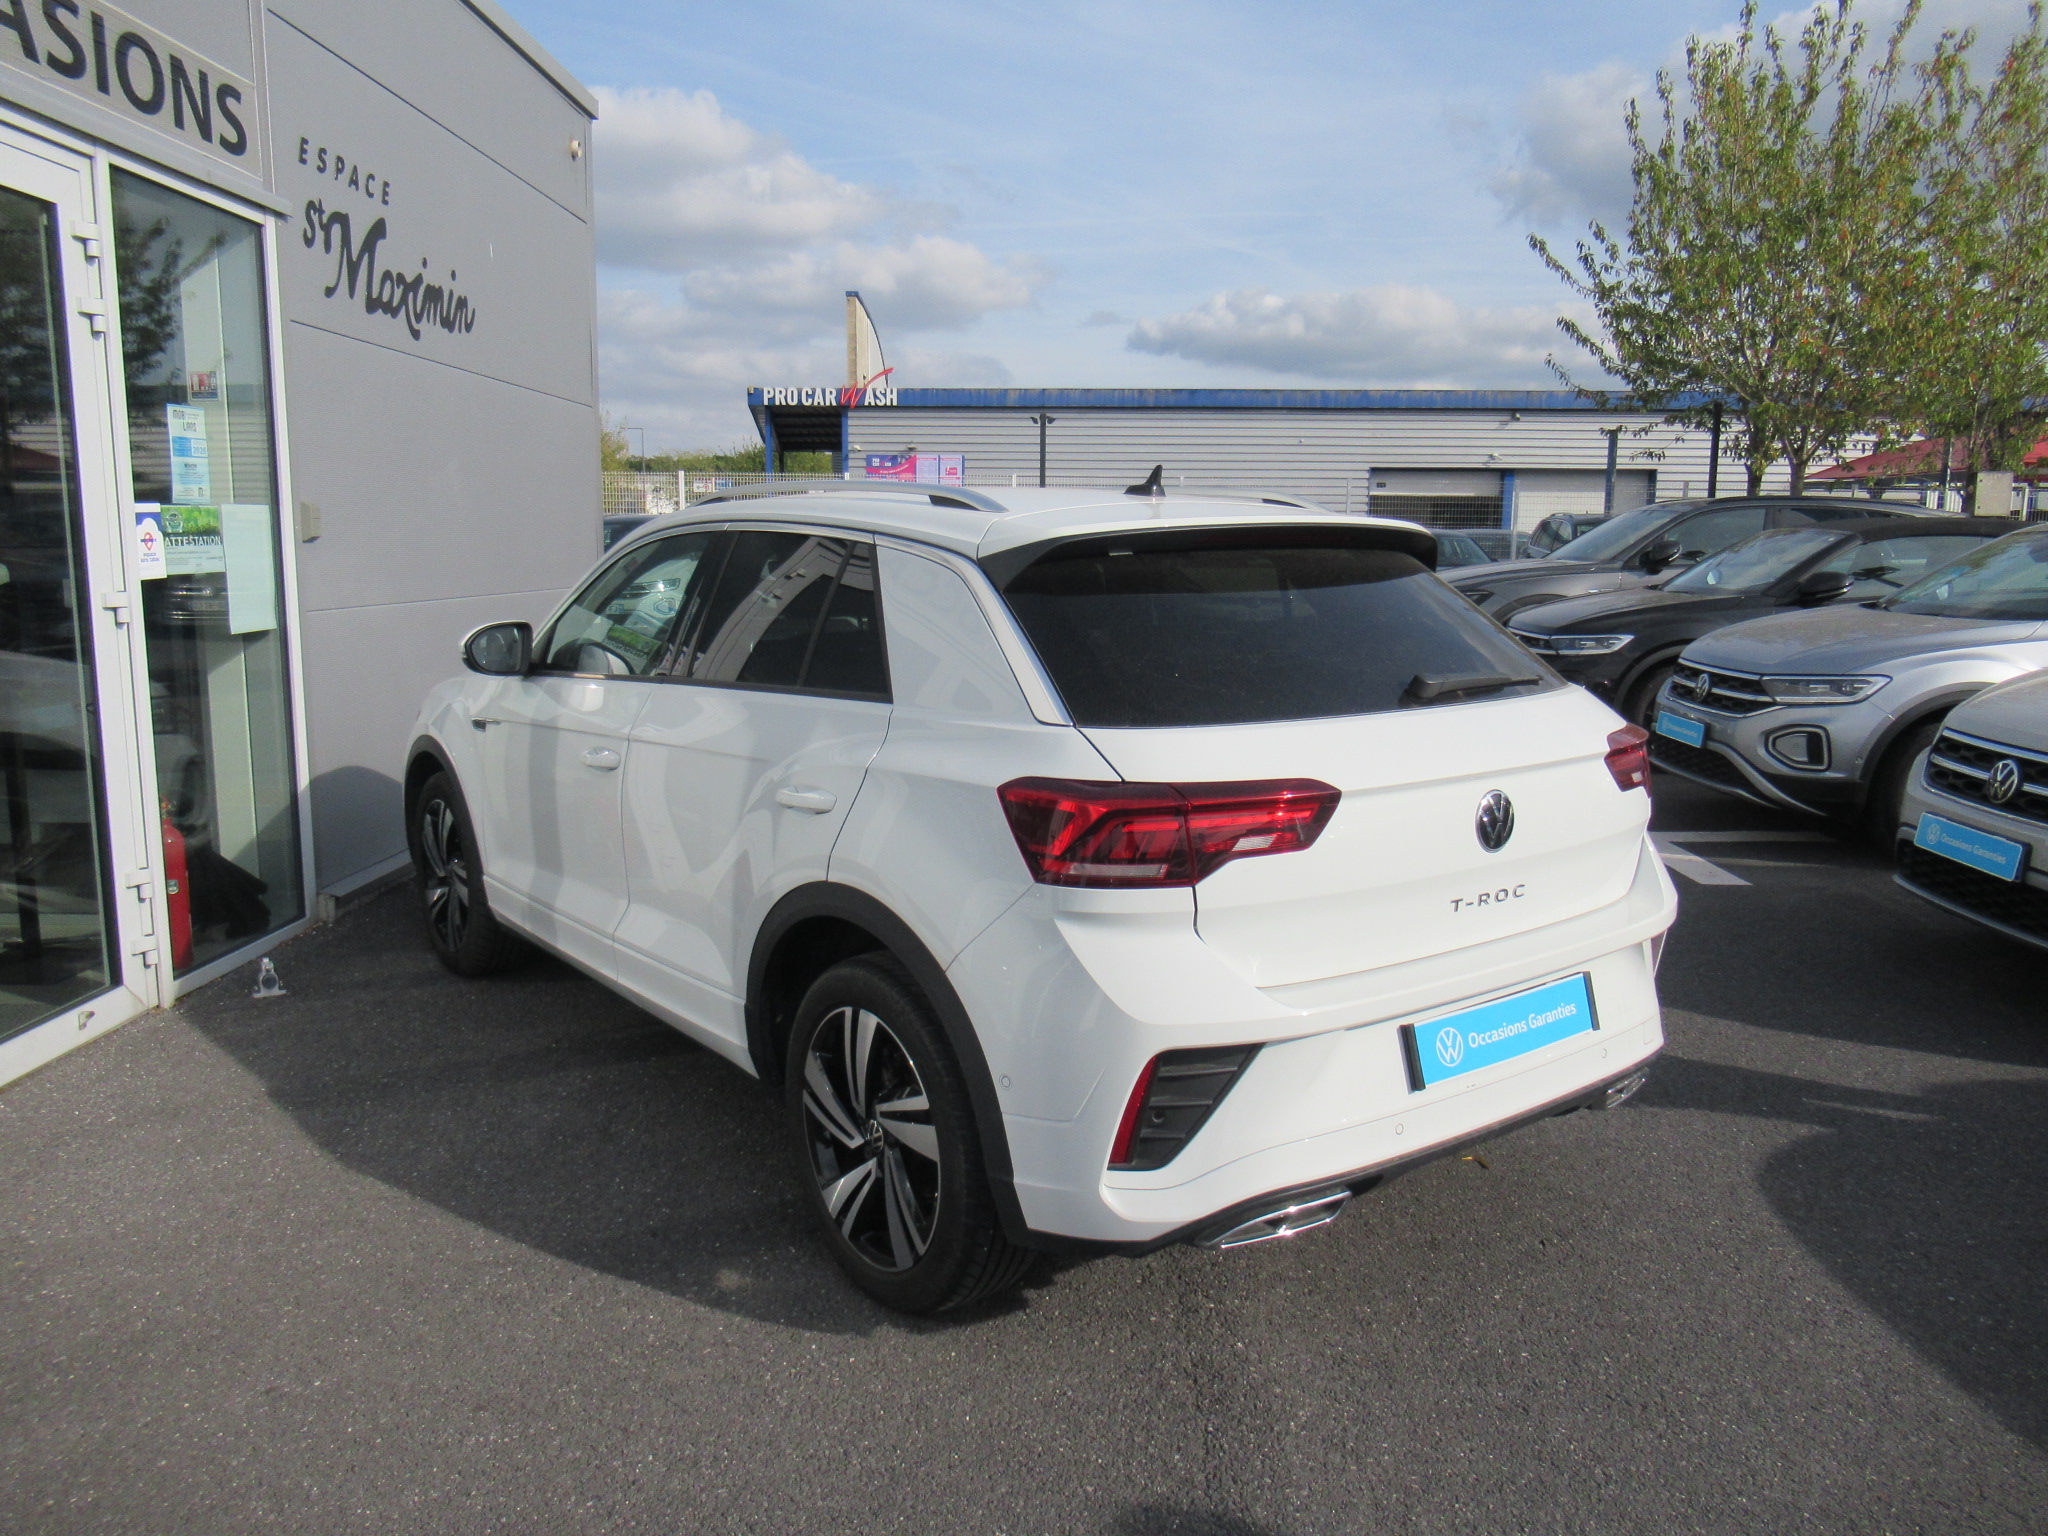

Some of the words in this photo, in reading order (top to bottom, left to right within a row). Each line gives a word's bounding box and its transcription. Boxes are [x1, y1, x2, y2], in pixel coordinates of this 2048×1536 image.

[298, 136, 390, 206] ESPACE
[324, 211, 476, 341] Maximin
[763, 387, 798, 406] PRO
[801, 387, 837, 406] CAR
[840, 367, 898, 408] WASH
[165, 536, 223, 547] ATTESTATION
[1941, 833, 1972, 853] Occasions
[1973, 845, 2007, 864] Garanties
[1449, 884, 1526, 913] T-ROC
[1468, 1020, 1528, 1048] Occasions
[1529, 1003, 1577, 1029] Garanties
